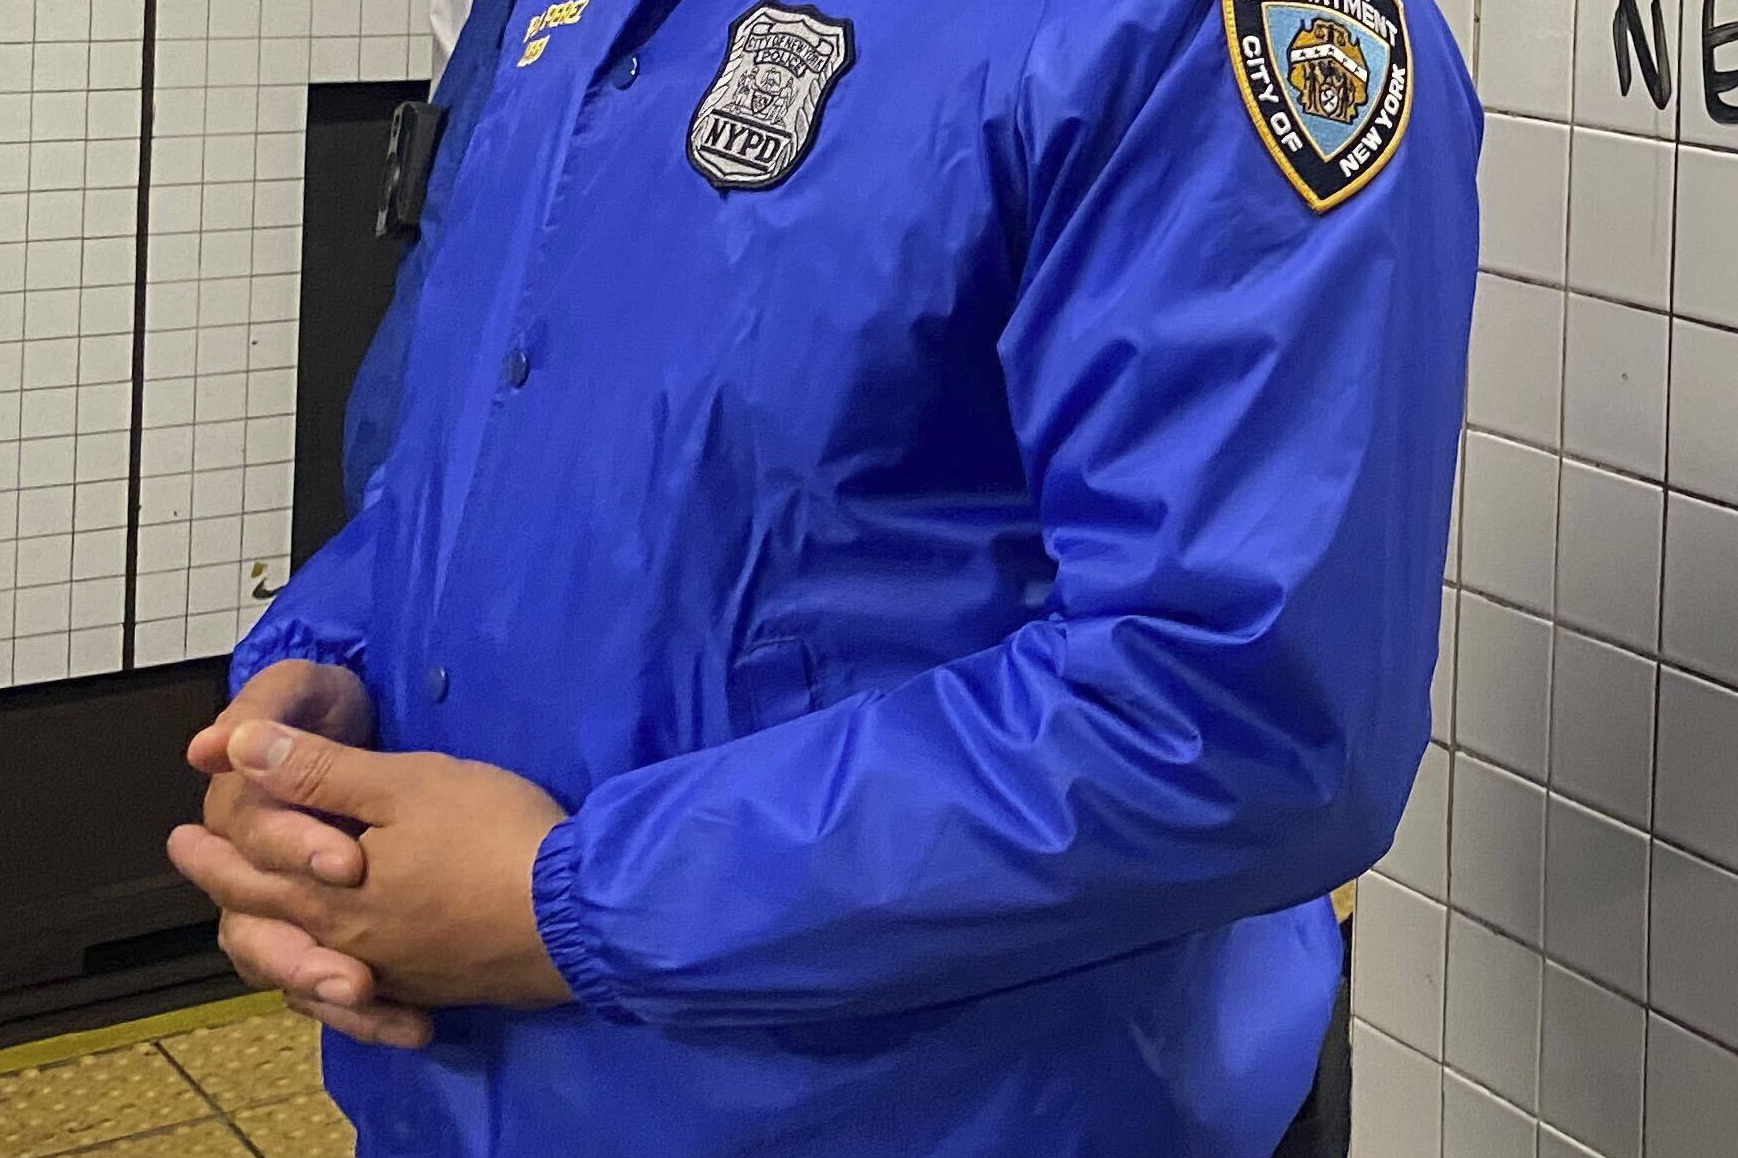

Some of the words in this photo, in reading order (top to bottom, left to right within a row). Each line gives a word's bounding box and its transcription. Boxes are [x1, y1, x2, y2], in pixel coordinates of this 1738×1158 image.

[706, 118, 782, 163] NYPD
[1241, 34, 1280, 105] CITY
[1269, 111, 1304, 153] OF
[1338, 125, 1384, 178] NEW
[1373, 63, 1407, 130] YORK
